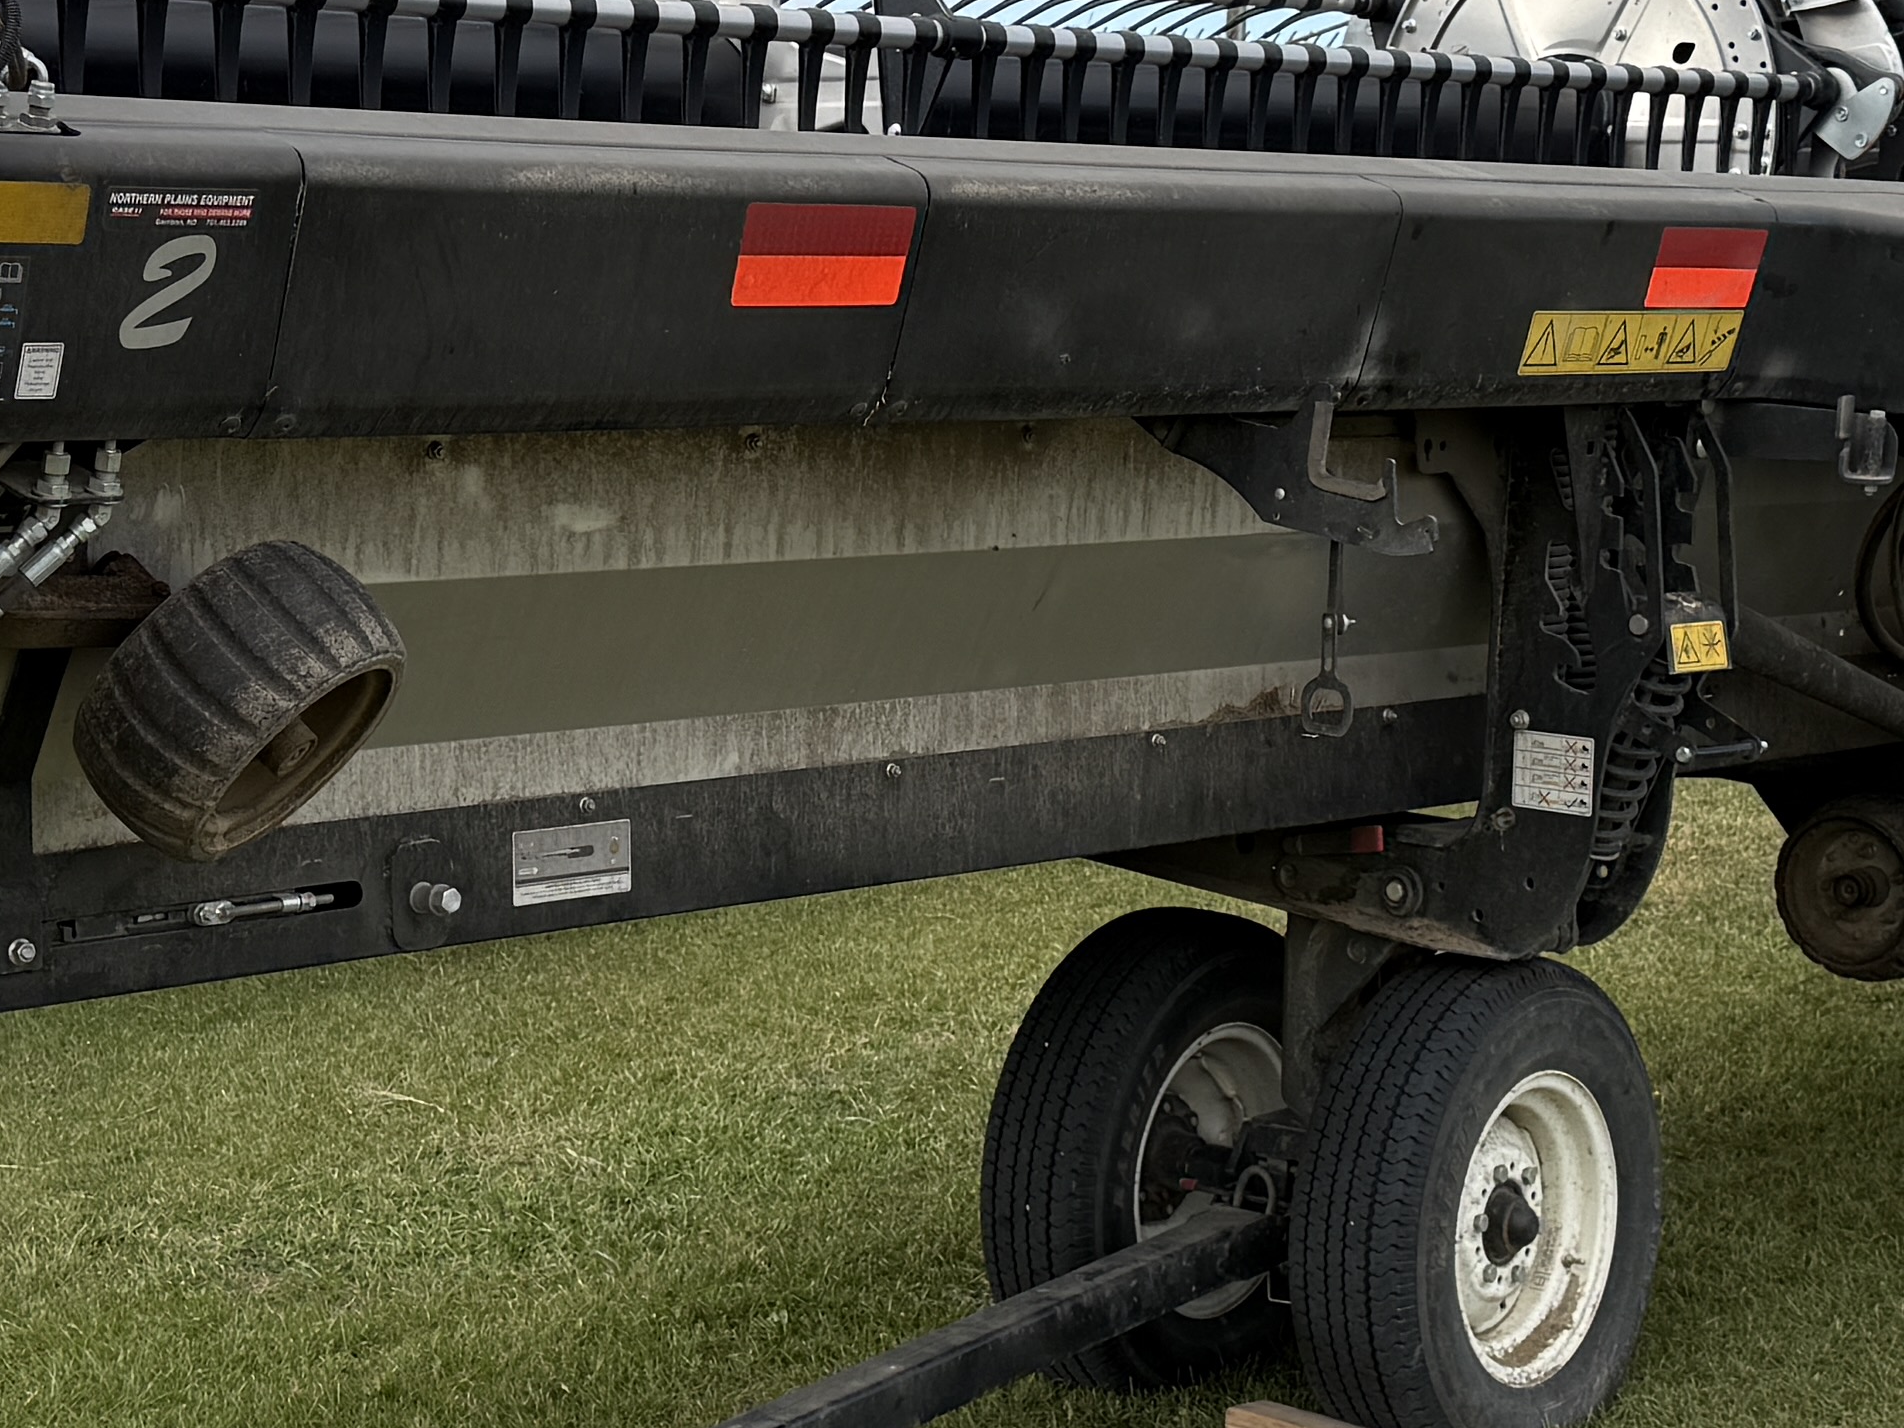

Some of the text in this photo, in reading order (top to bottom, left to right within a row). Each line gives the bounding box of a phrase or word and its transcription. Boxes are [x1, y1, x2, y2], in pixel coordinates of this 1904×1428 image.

[109, 193, 255, 206] NORTHERN PLAINS EQUIPMENT
[119, 234, 217, 349] 2
